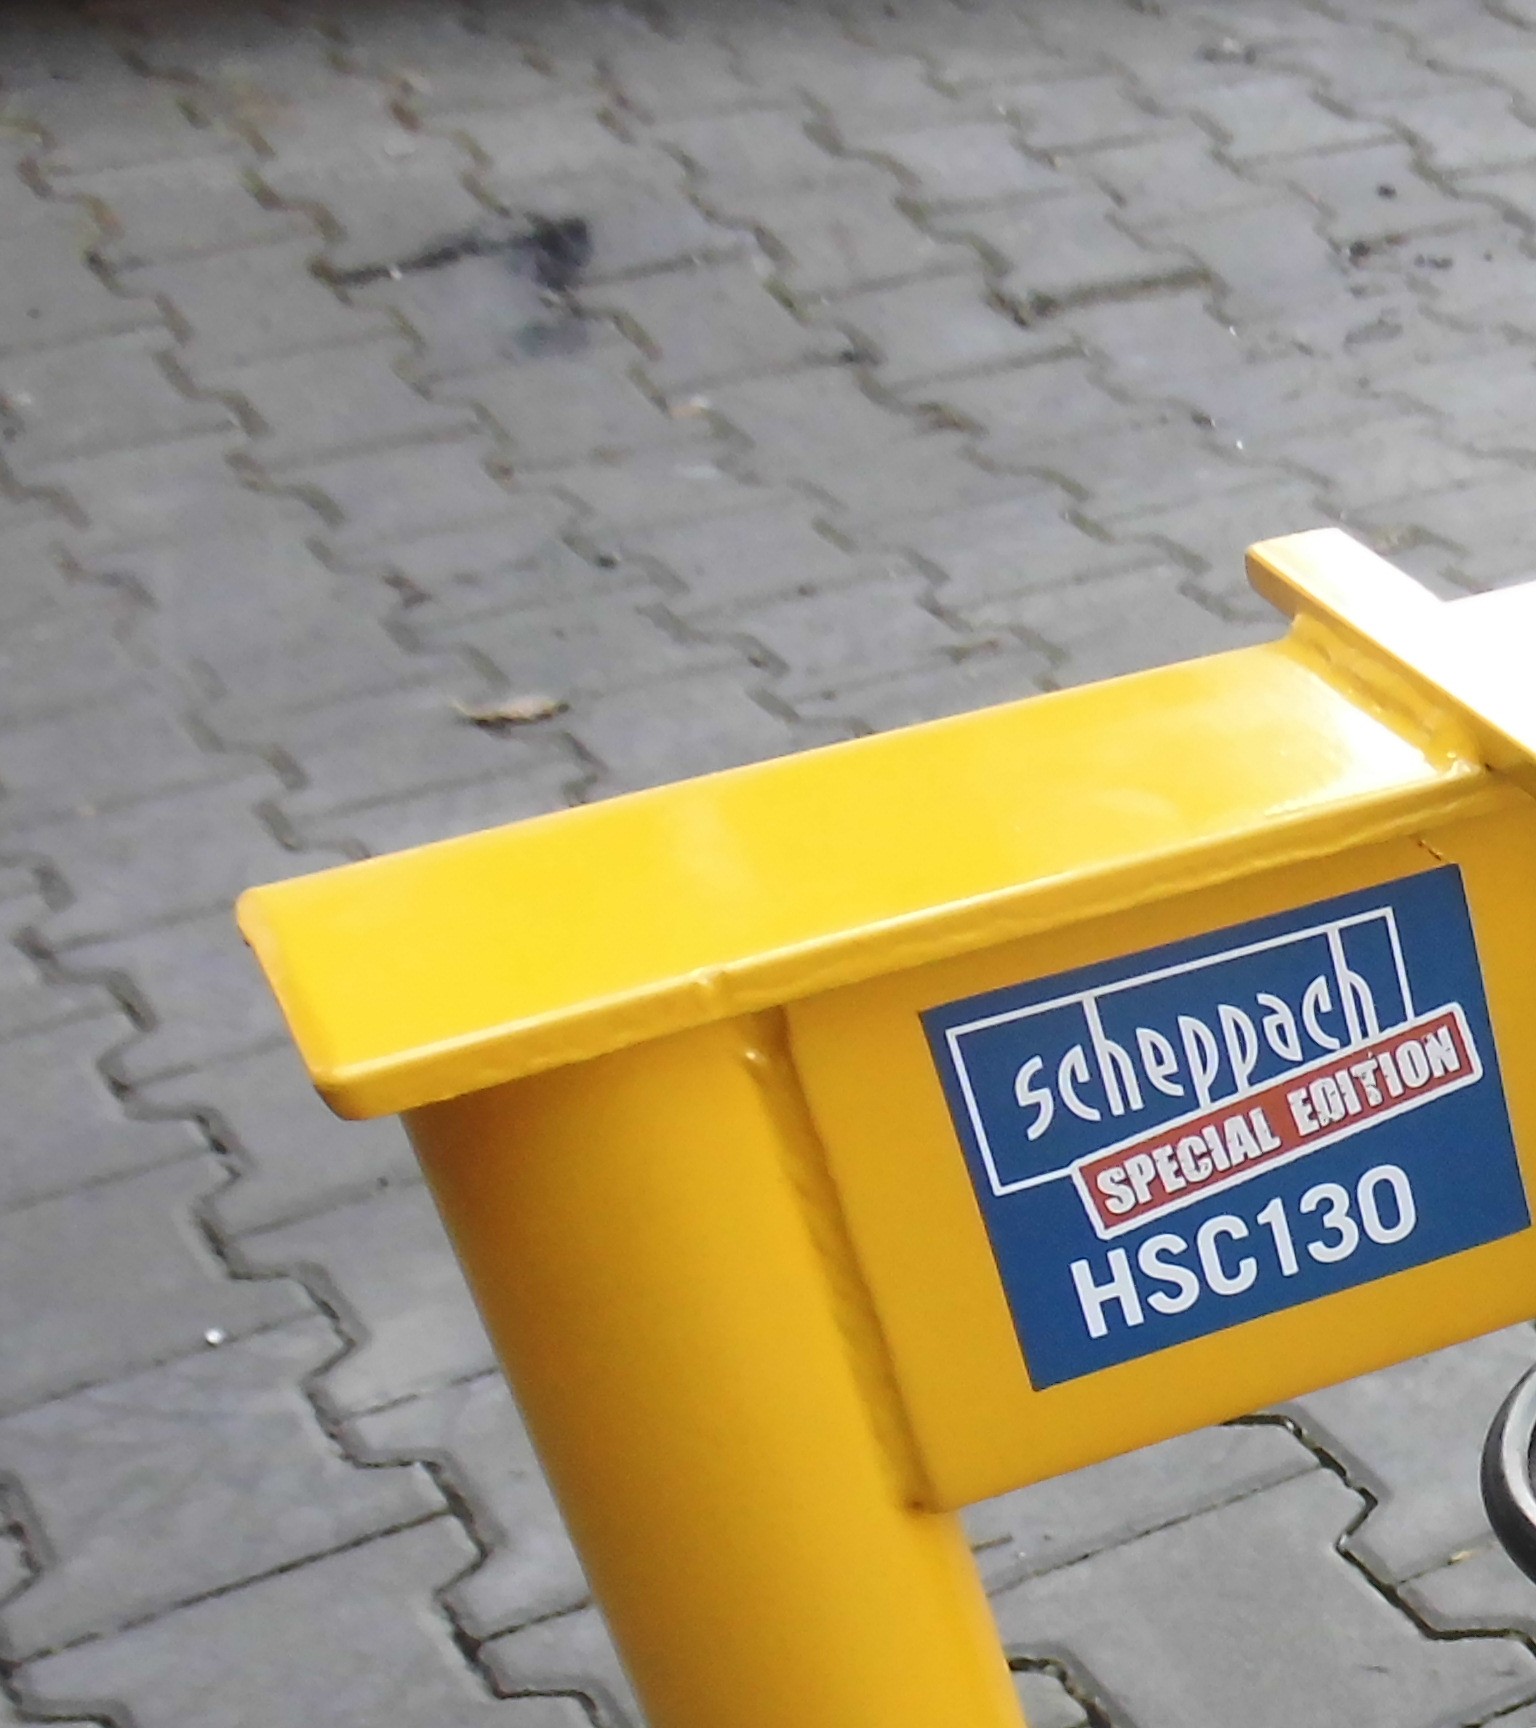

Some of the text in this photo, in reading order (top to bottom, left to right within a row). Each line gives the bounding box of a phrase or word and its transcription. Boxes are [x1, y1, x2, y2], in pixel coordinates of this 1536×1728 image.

[1014, 925, 1380, 1140] scheppach
[1095, 1026, 1461, 1216] SPECIAL EDITION
[1070, 1164, 1417, 1339] HSC130
